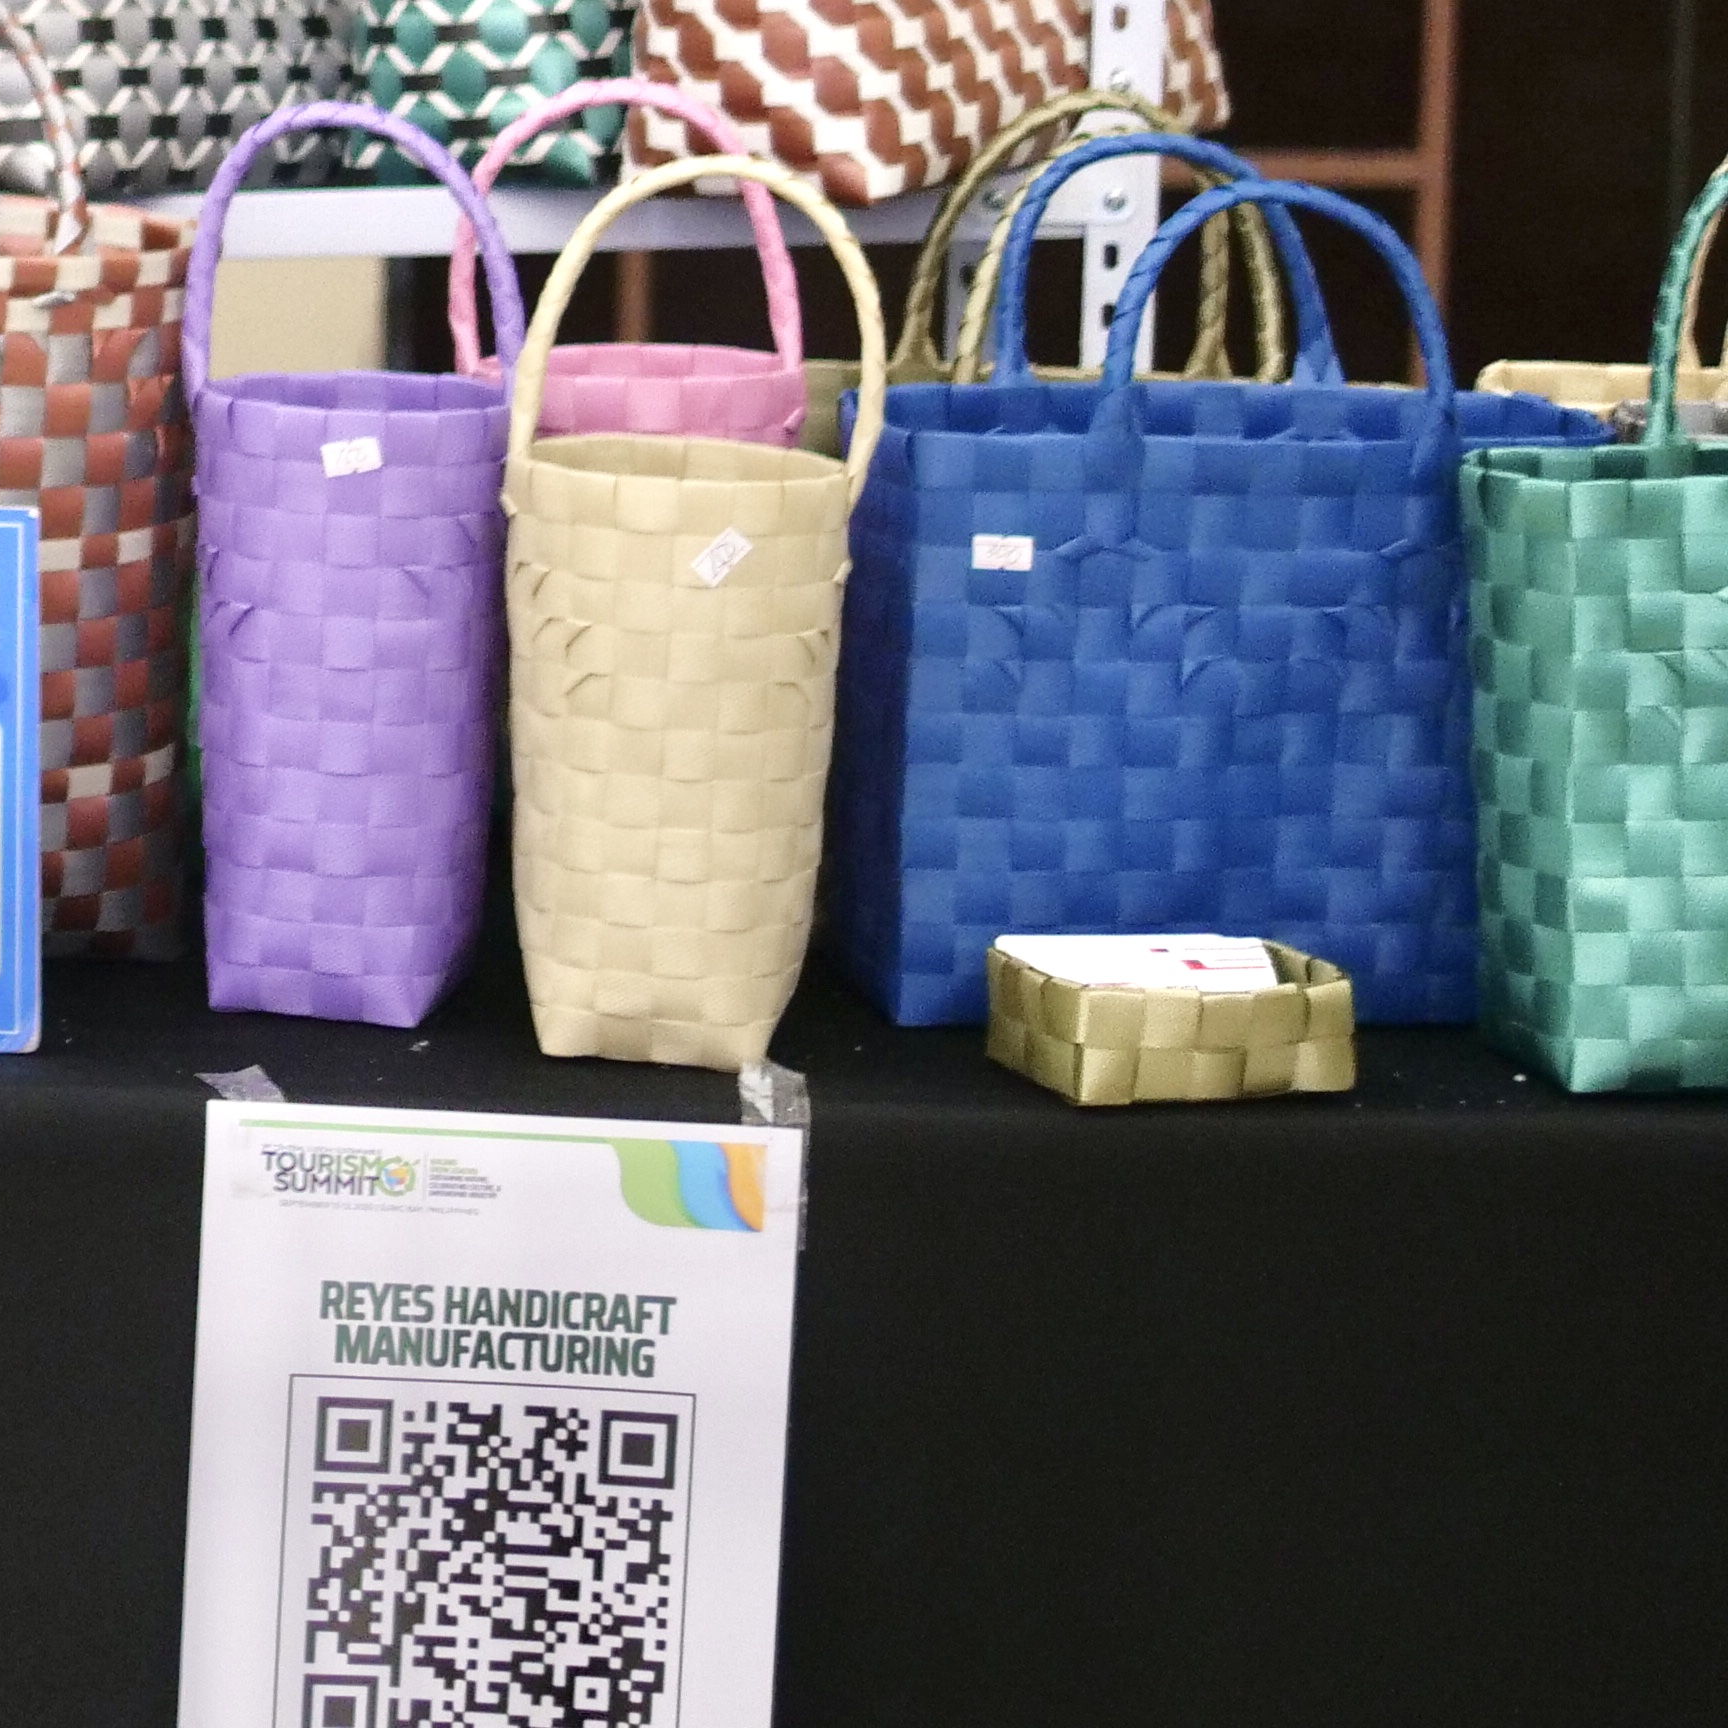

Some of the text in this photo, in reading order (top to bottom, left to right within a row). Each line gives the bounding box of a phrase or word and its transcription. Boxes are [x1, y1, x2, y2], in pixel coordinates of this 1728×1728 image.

[261, 1150, 382, 1176] TOURISM
[273, 1171, 380, 1197] SUMMIT
[319, 1279, 678, 1336] REYES HANDICRAFT
[334, 1323, 656, 1378] MANUFACTURING
